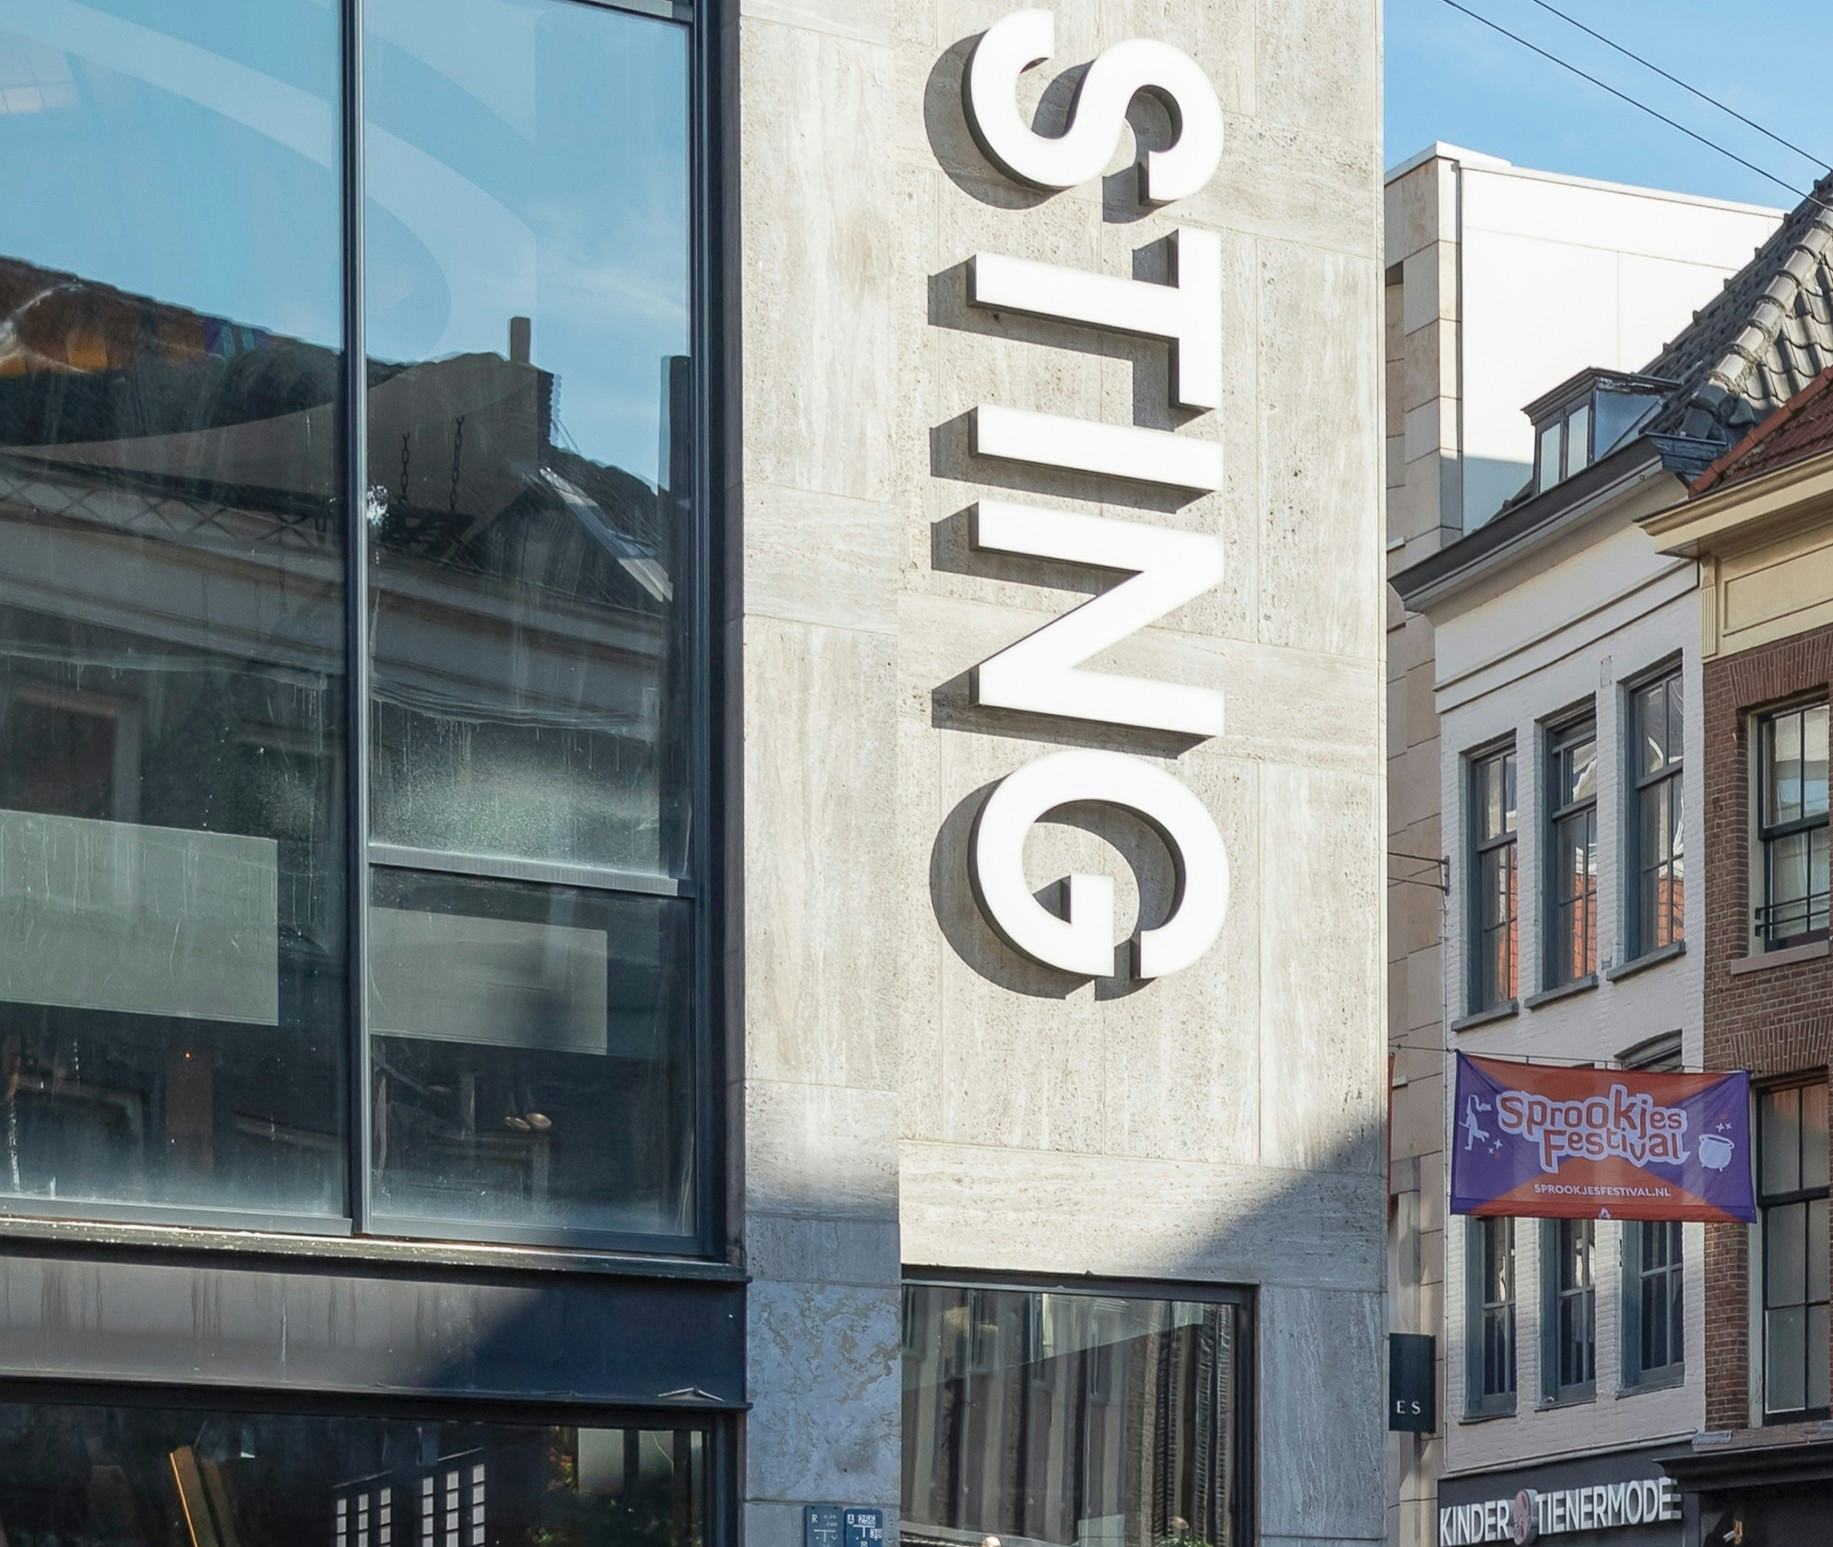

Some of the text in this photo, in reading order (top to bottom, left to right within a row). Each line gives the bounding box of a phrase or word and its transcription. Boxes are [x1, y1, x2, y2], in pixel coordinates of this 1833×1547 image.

[961, 9, 1229, 980] STING
[1498, 1087, 1685, 1141] Sprookjes
[1542, 1127, 1685, 1169] Festival
[1534, 1183, 1671, 1198] SPROOKJESFESTIVAL.NL
[1440, 1477, 1676, 1547] KINDER TIENERMODE
